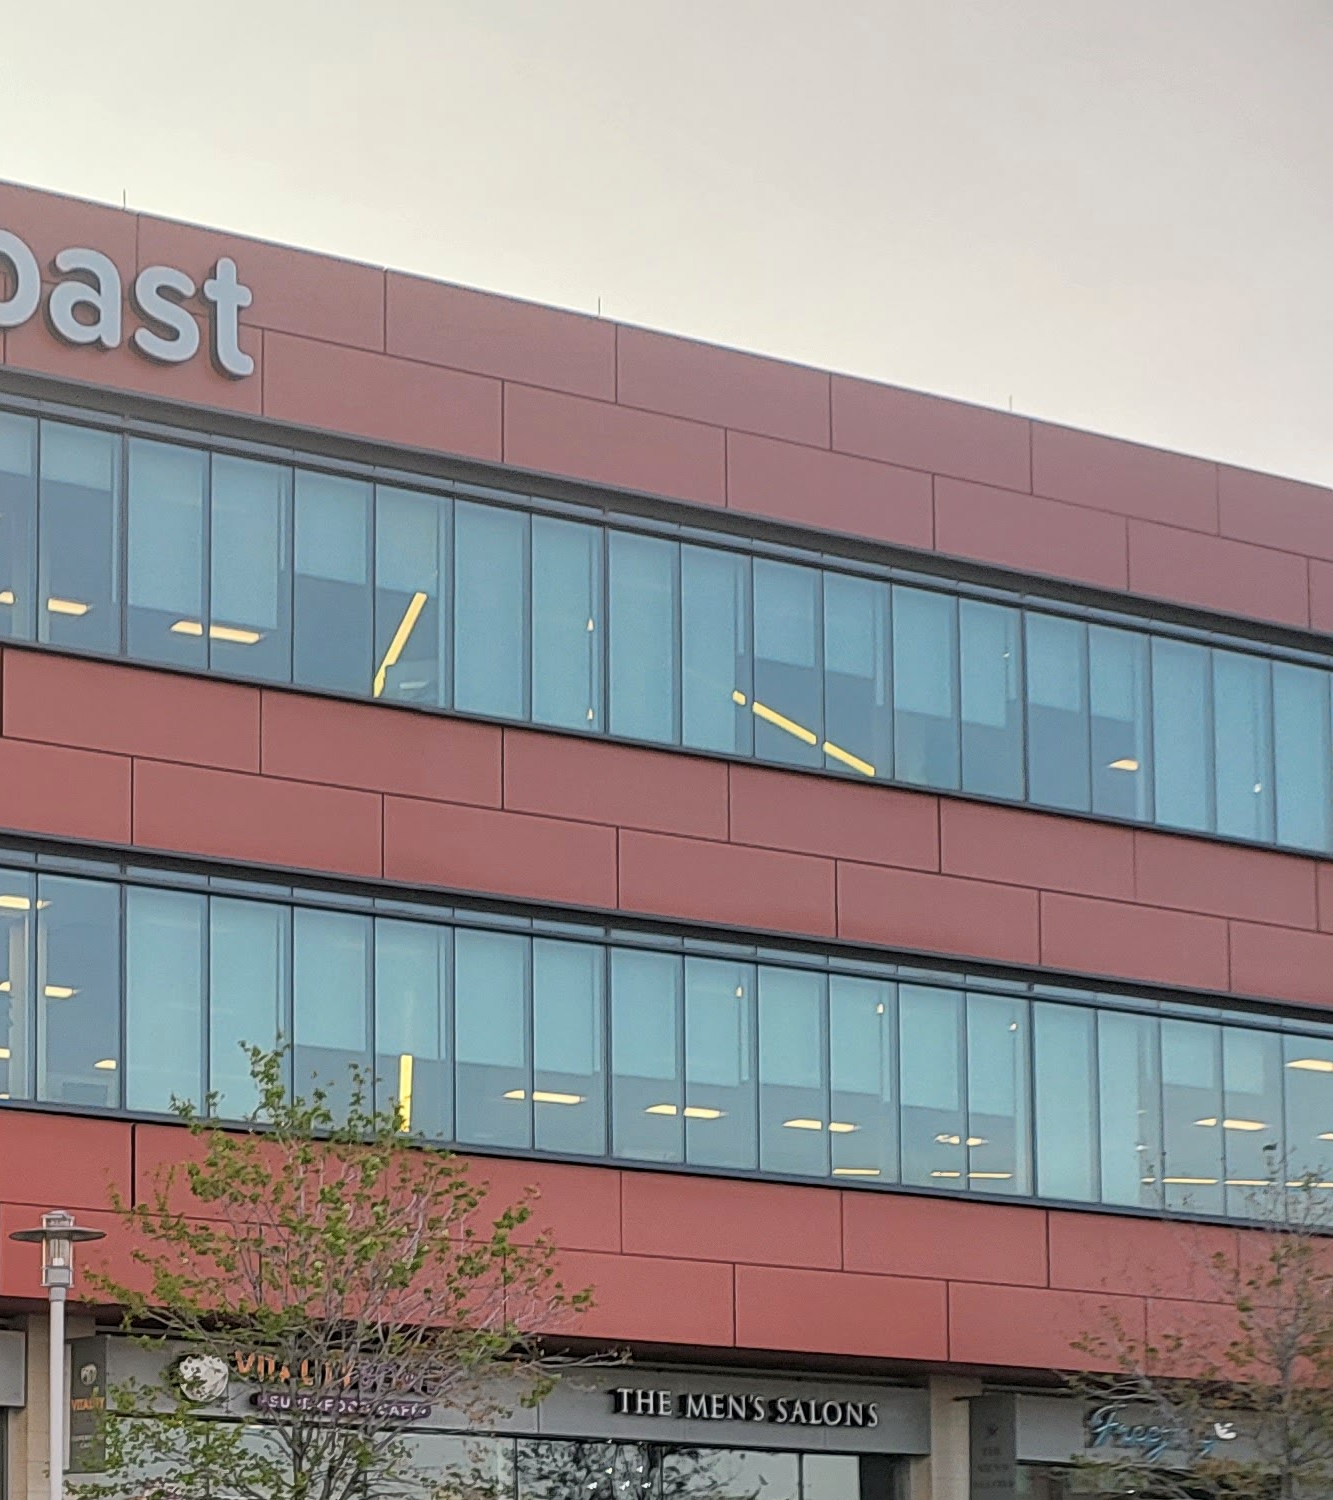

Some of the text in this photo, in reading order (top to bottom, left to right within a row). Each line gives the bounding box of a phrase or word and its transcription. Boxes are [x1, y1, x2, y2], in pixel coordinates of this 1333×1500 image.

[235, 1350, 355, 1388] VITLTY
[269, 1395, 371, 1414] SUEFOO
[616, 1387, 879, 1428] THE MEN'S SALONS
